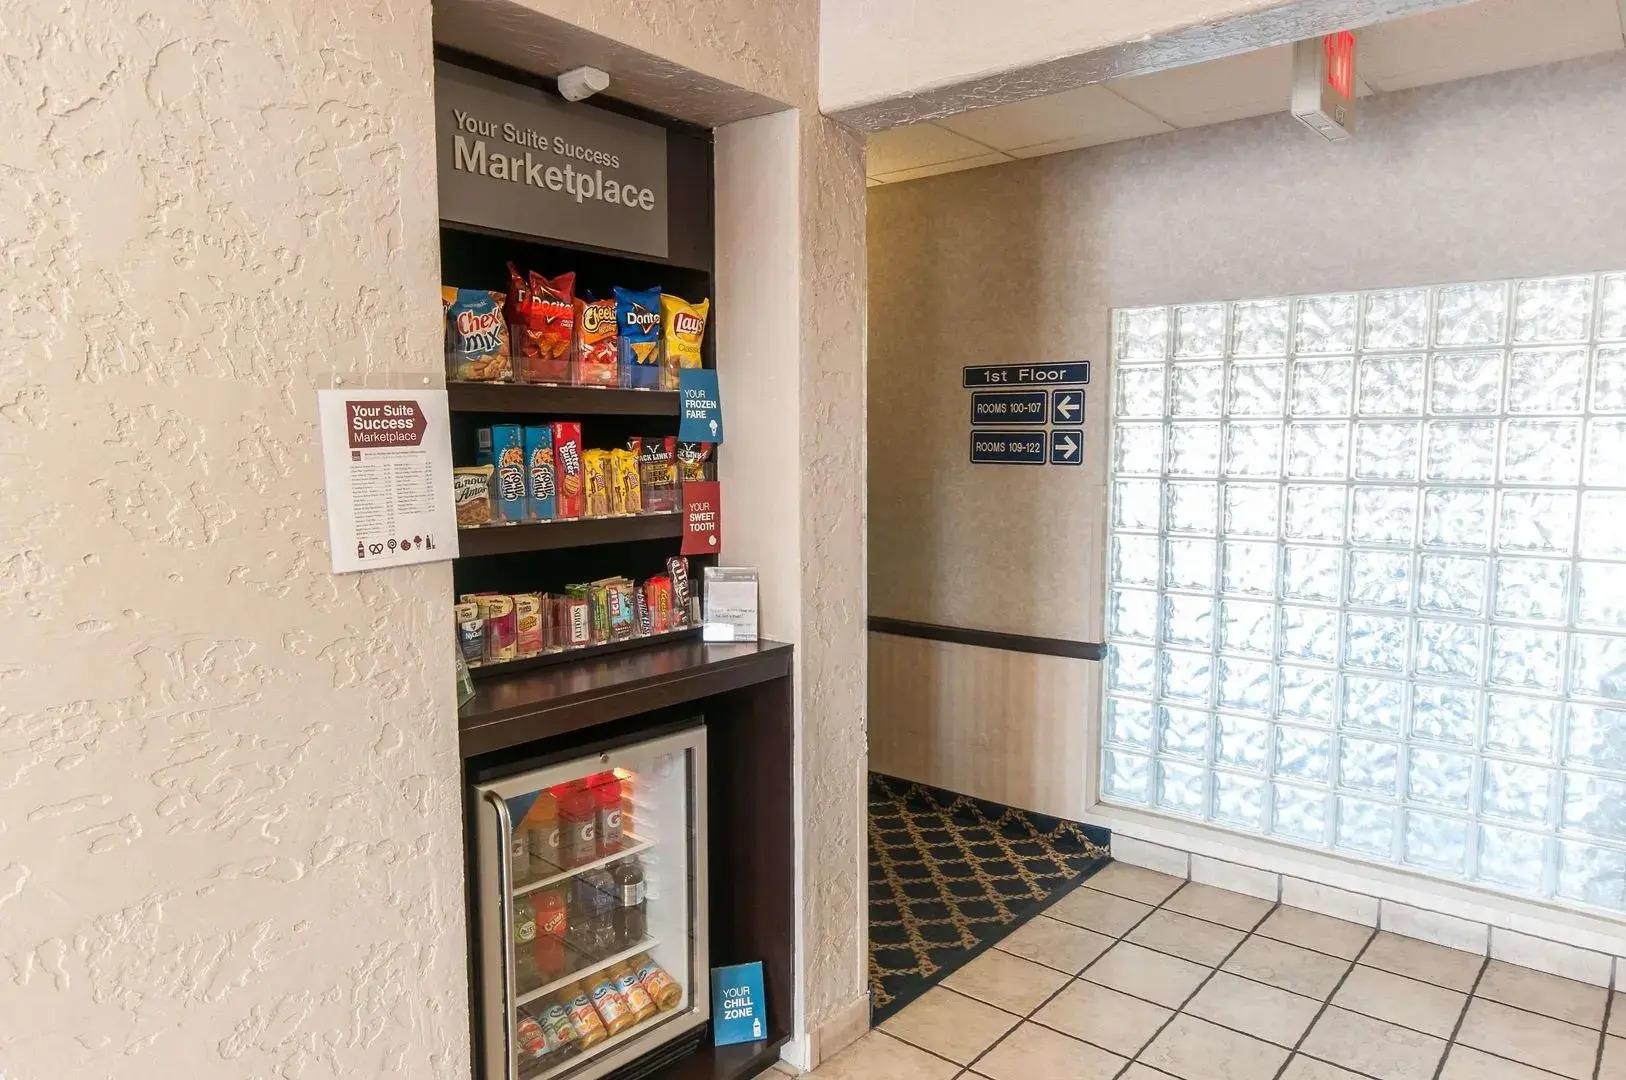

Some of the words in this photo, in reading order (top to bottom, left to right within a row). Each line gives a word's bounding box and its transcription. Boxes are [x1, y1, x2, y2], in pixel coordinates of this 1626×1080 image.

[453, 109, 498, 138] Your
[503, 122, 549, 151] Suite
[552, 136, 620, 169] Success
[453, 135, 656, 211] Marketplace
[458, 307, 500, 335] Chex
[984, 370, 1008, 382] 1st
[1018, 368, 1067, 381] Floor
[684, 389, 706, 399] YOUR
[685, 400, 717, 409] FROZEN
[977, 403, 1007, 414] ROOMS
[1010, 402, 1041, 413] 100-107
[352, 405, 381, 417] Your
[383, 405, 414, 416] Suite
[686, 410, 707, 419] FARE
[354, 432, 417, 443] Marketplace
[976, 442, 1006, 452] ROOMS
[1009, 442, 1041, 453] 109-122
[560, 446, 575, 476] Butter
[566, 440, 580, 472] Nutter
[689, 502, 709, 511] YOUR
[689, 512, 715, 522] SWEET
[689, 523, 715, 531] TOOTH
[574, 607, 583, 639] ALTOIDS
[607, 810, 620, 828] G
[581, 823, 594, 841] G
[723, 986, 750, 998] YOUR
[724, 997, 753, 1008] CHILL
[724, 1008, 752, 1019] ZONE
